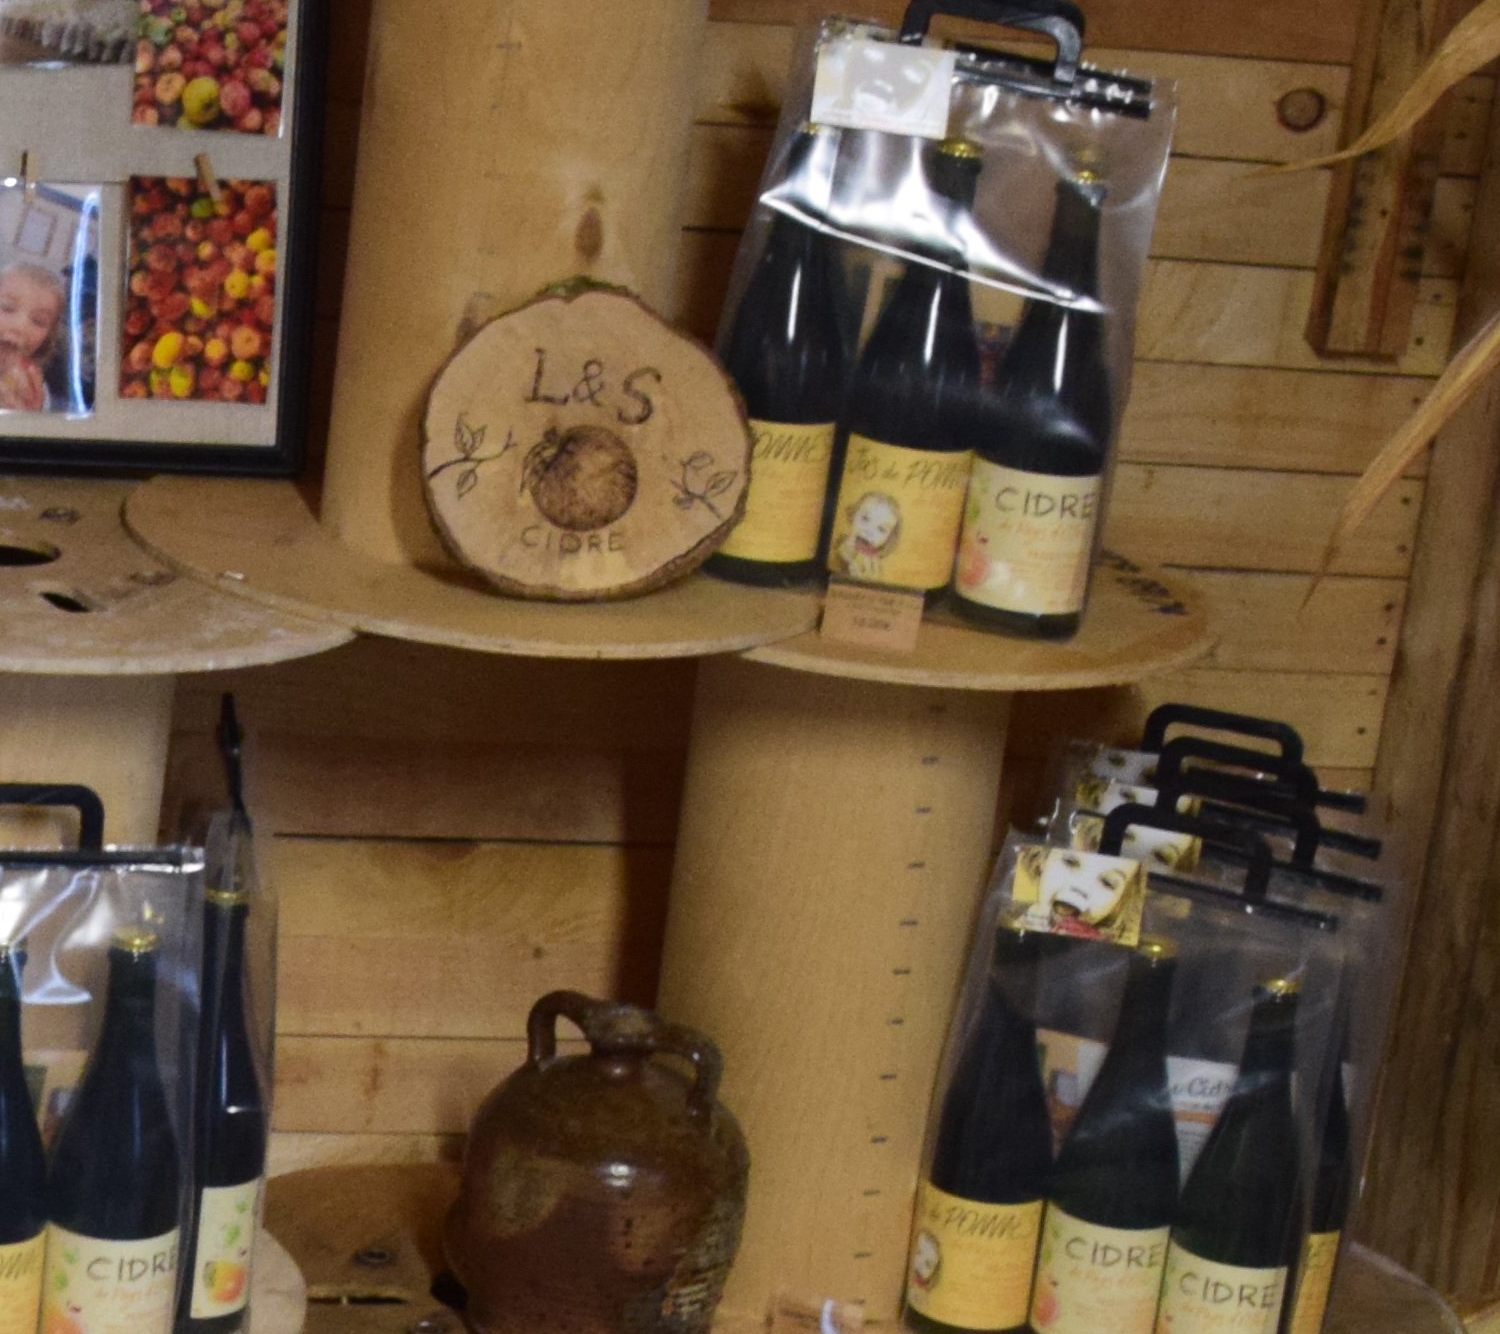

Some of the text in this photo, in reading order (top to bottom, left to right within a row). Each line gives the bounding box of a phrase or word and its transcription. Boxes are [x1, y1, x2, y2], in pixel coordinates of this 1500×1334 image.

[525, 347, 662, 425] L&S
[995, 486, 1095, 519] CIDRE
[520, 524, 625, 554] CIDRE
[1065, 1235, 1167, 1269] CIDRE
[1179, 1271, 1279, 1310] CIDRE
